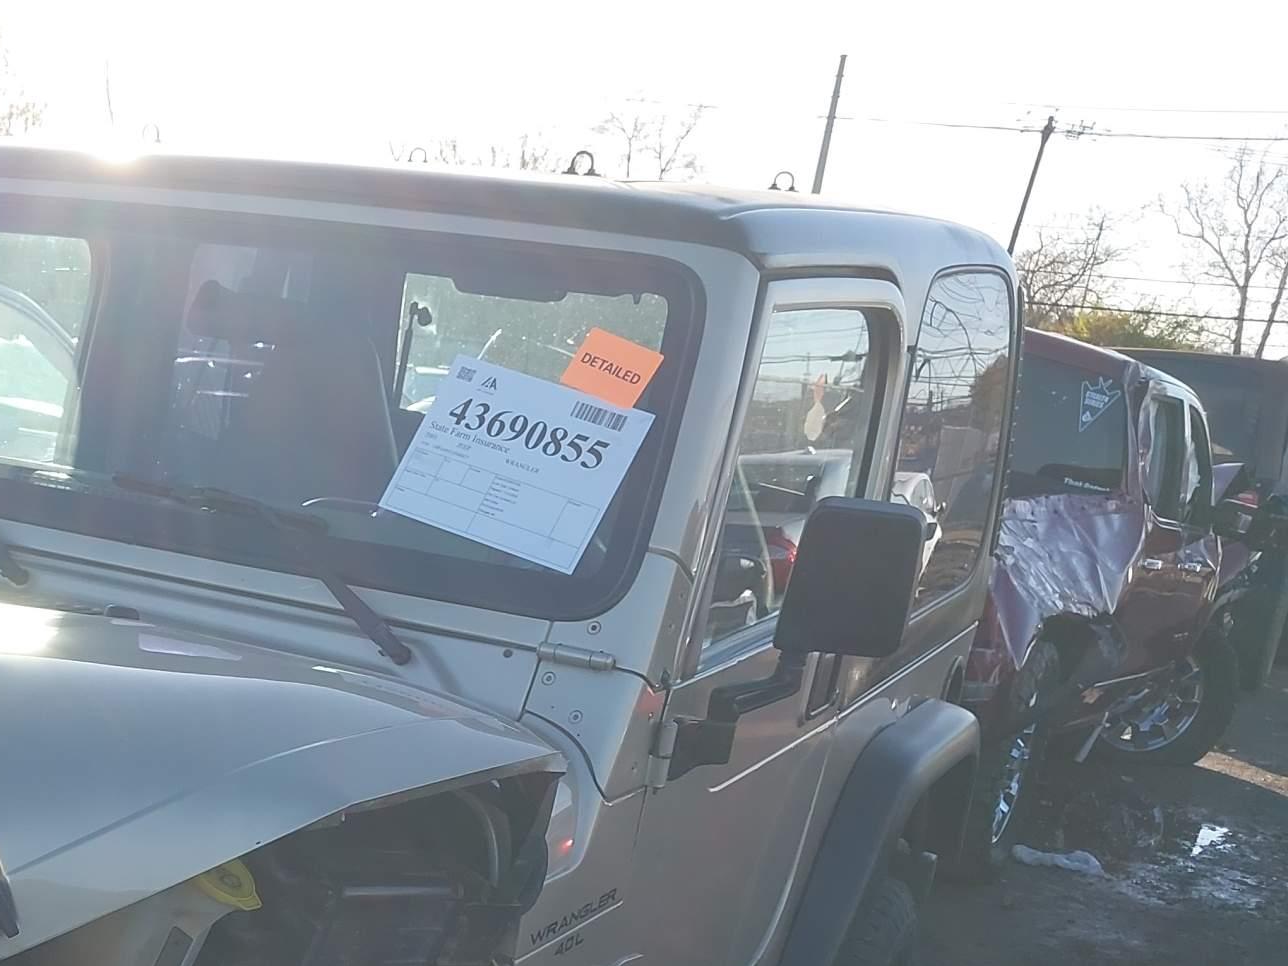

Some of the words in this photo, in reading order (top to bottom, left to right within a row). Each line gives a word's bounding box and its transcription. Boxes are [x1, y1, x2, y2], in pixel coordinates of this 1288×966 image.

[579, 351, 642, 386] DETAILED
[430, 420, 449, 434] State
[450, 426, 472, 442] Farm
[472, 434, 511, 455] Insurance
[448, 398, 611, 470] 43690855
[529, 887, 618, 947] WRANGLER
